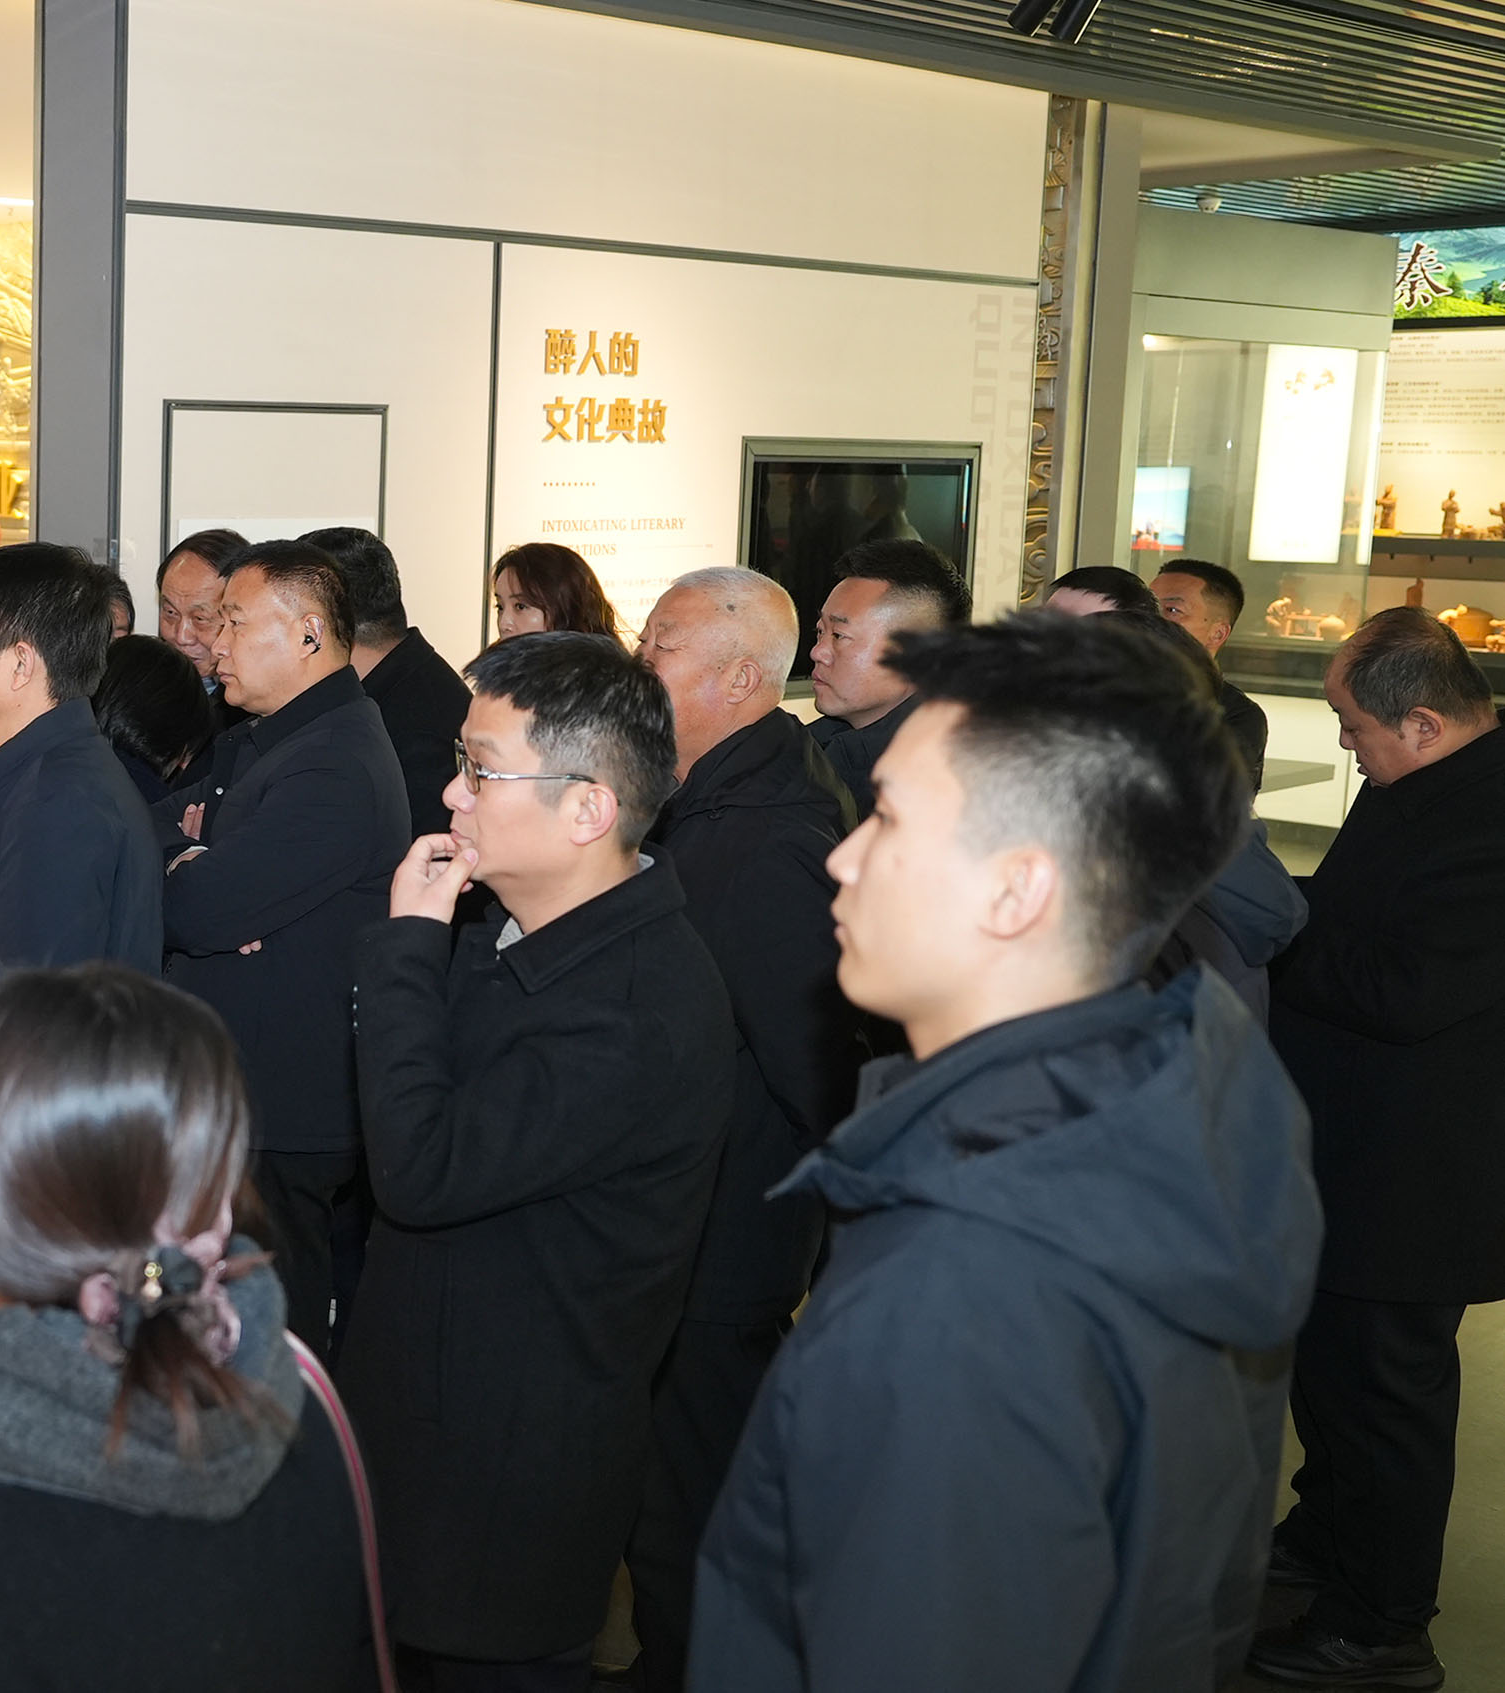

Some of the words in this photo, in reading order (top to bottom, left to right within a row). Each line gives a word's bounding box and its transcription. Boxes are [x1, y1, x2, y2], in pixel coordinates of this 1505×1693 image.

[544, 328, 639, 376] 醉人的
[542, 397, 668, 443] 文化典故
[542, 519, 627, 533] INTOXICATING
[630, 517, 686, 531] LITERARY
